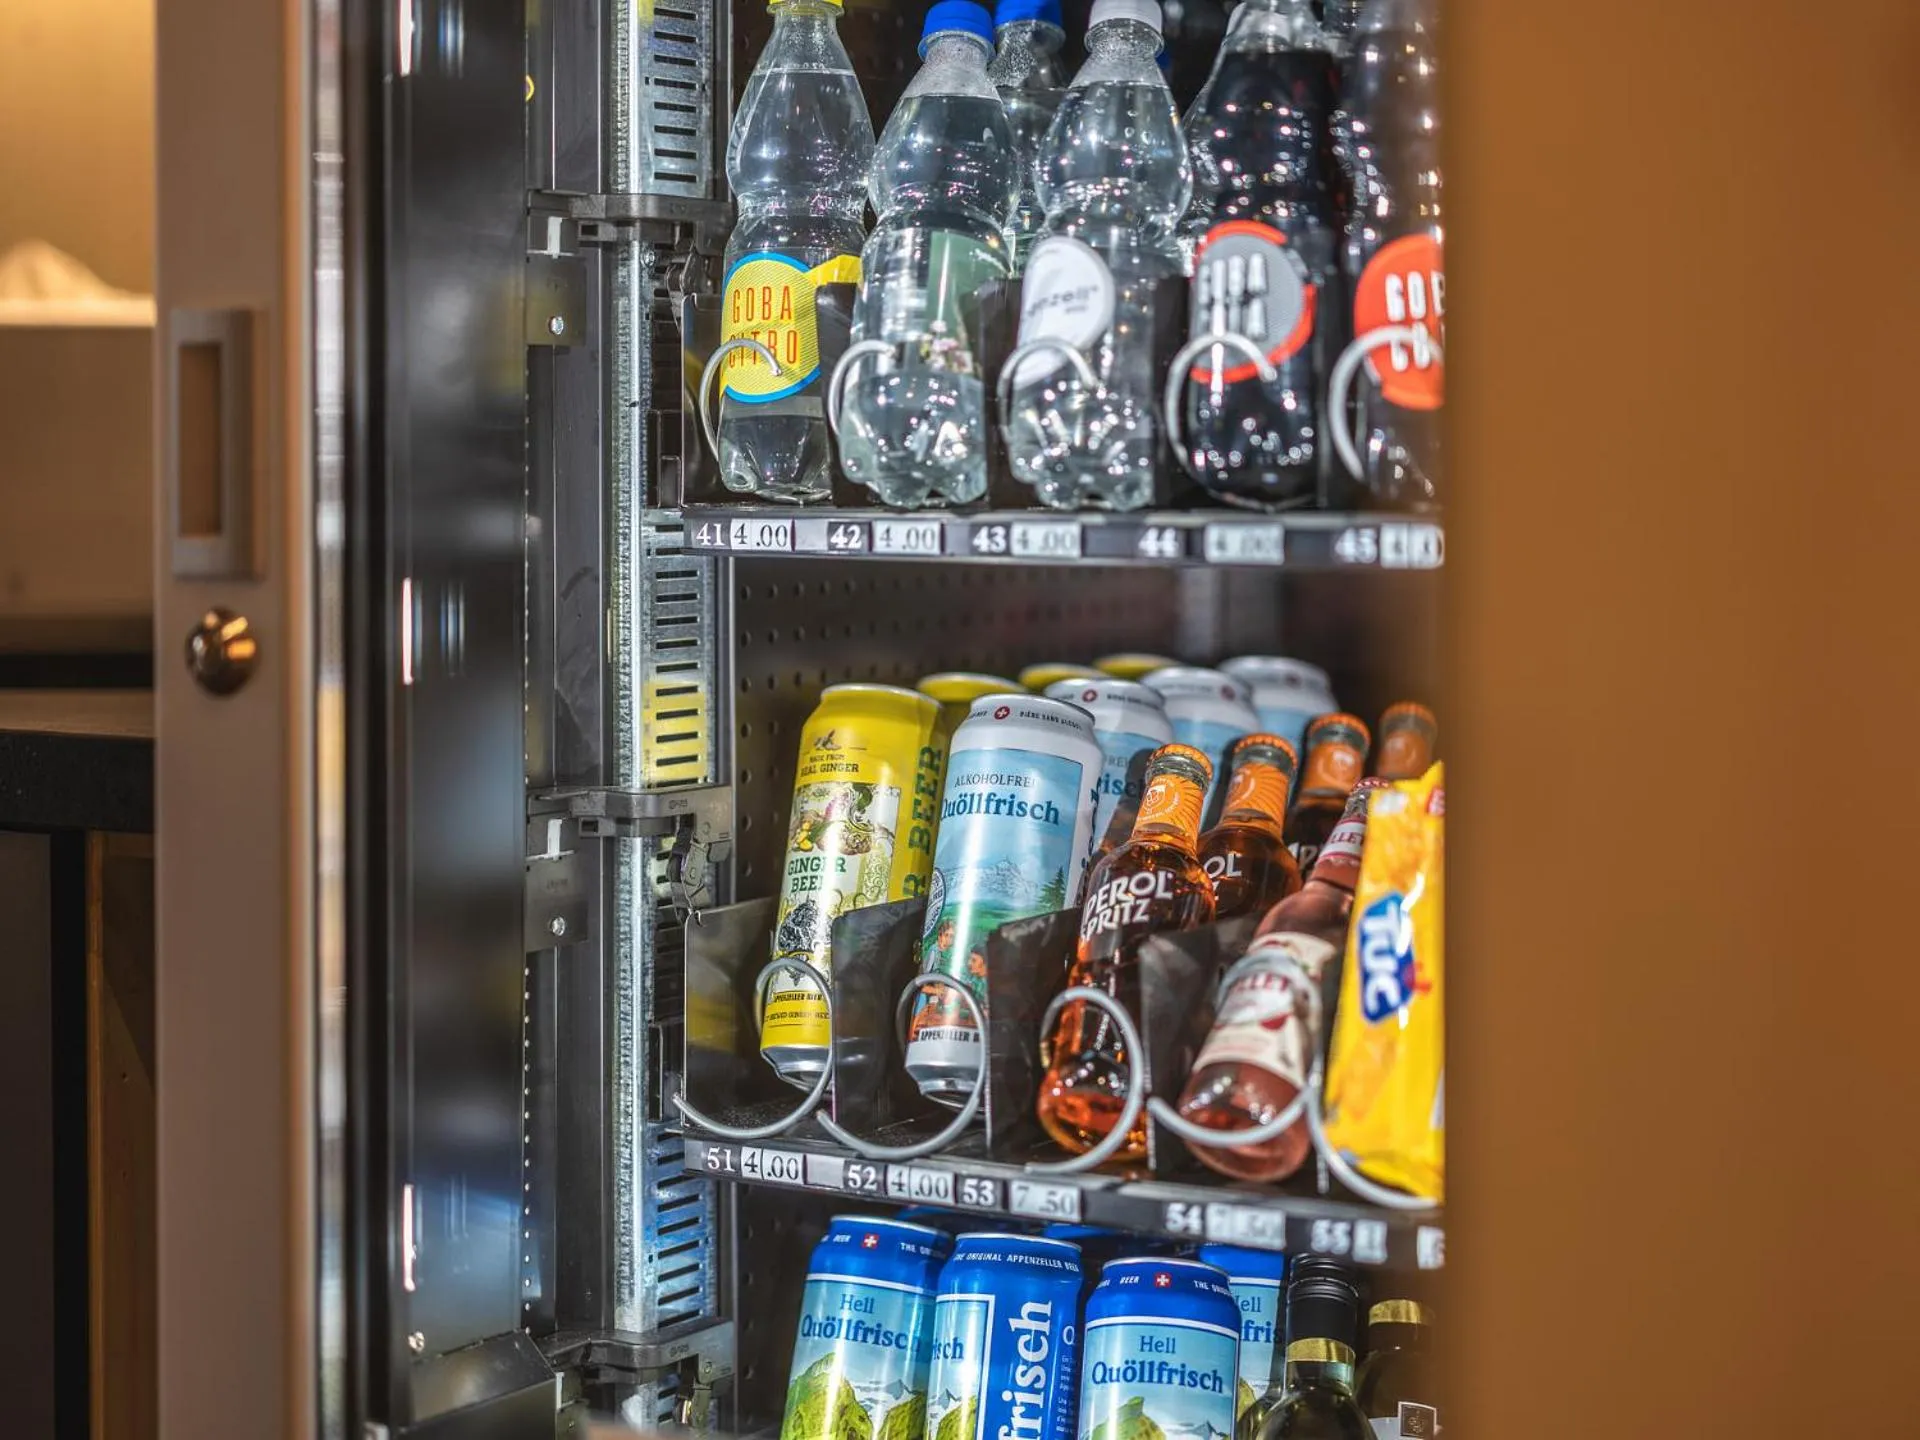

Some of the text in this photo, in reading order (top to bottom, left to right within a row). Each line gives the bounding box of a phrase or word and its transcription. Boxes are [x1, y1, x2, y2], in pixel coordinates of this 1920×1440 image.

[732, 285, 793, 324] GOBA
[728, 329, 798, 369] CITRO
[695, 523, 789, 548] 41 4.00
[830, 524, 937, 551] 42 4.00
[972, 525, 1007, 553] 43
[820, 762, 860, 774] GINGER
[788, 857, 847, 876] GINGR
[1085, 869, 1174, 922] PEROL
[707, 1147, 799, 1181] 51 4.00
[847, 1163, 950, 1200] 52 4.00
[963, 1178, 1075, 1216] 53 7.50
[966, 1252, 1002, 1262] ORIGINAL
[1006, 1254, 1064, 1269] APPENZELLER
[1119, 1275, 1140, 1285] BEER
[1194, 1279, 1209, 1291] THE
[840, 1293, 875, 1315] Hell
[1235, 1295, 1261, 1313] ell
[801, 1314, 921, 1354] Quöllfrisch
[1140, 1335, 1176, 1355] Hell
[1091, 1359, 1224, 1395] Quöllfrisch
